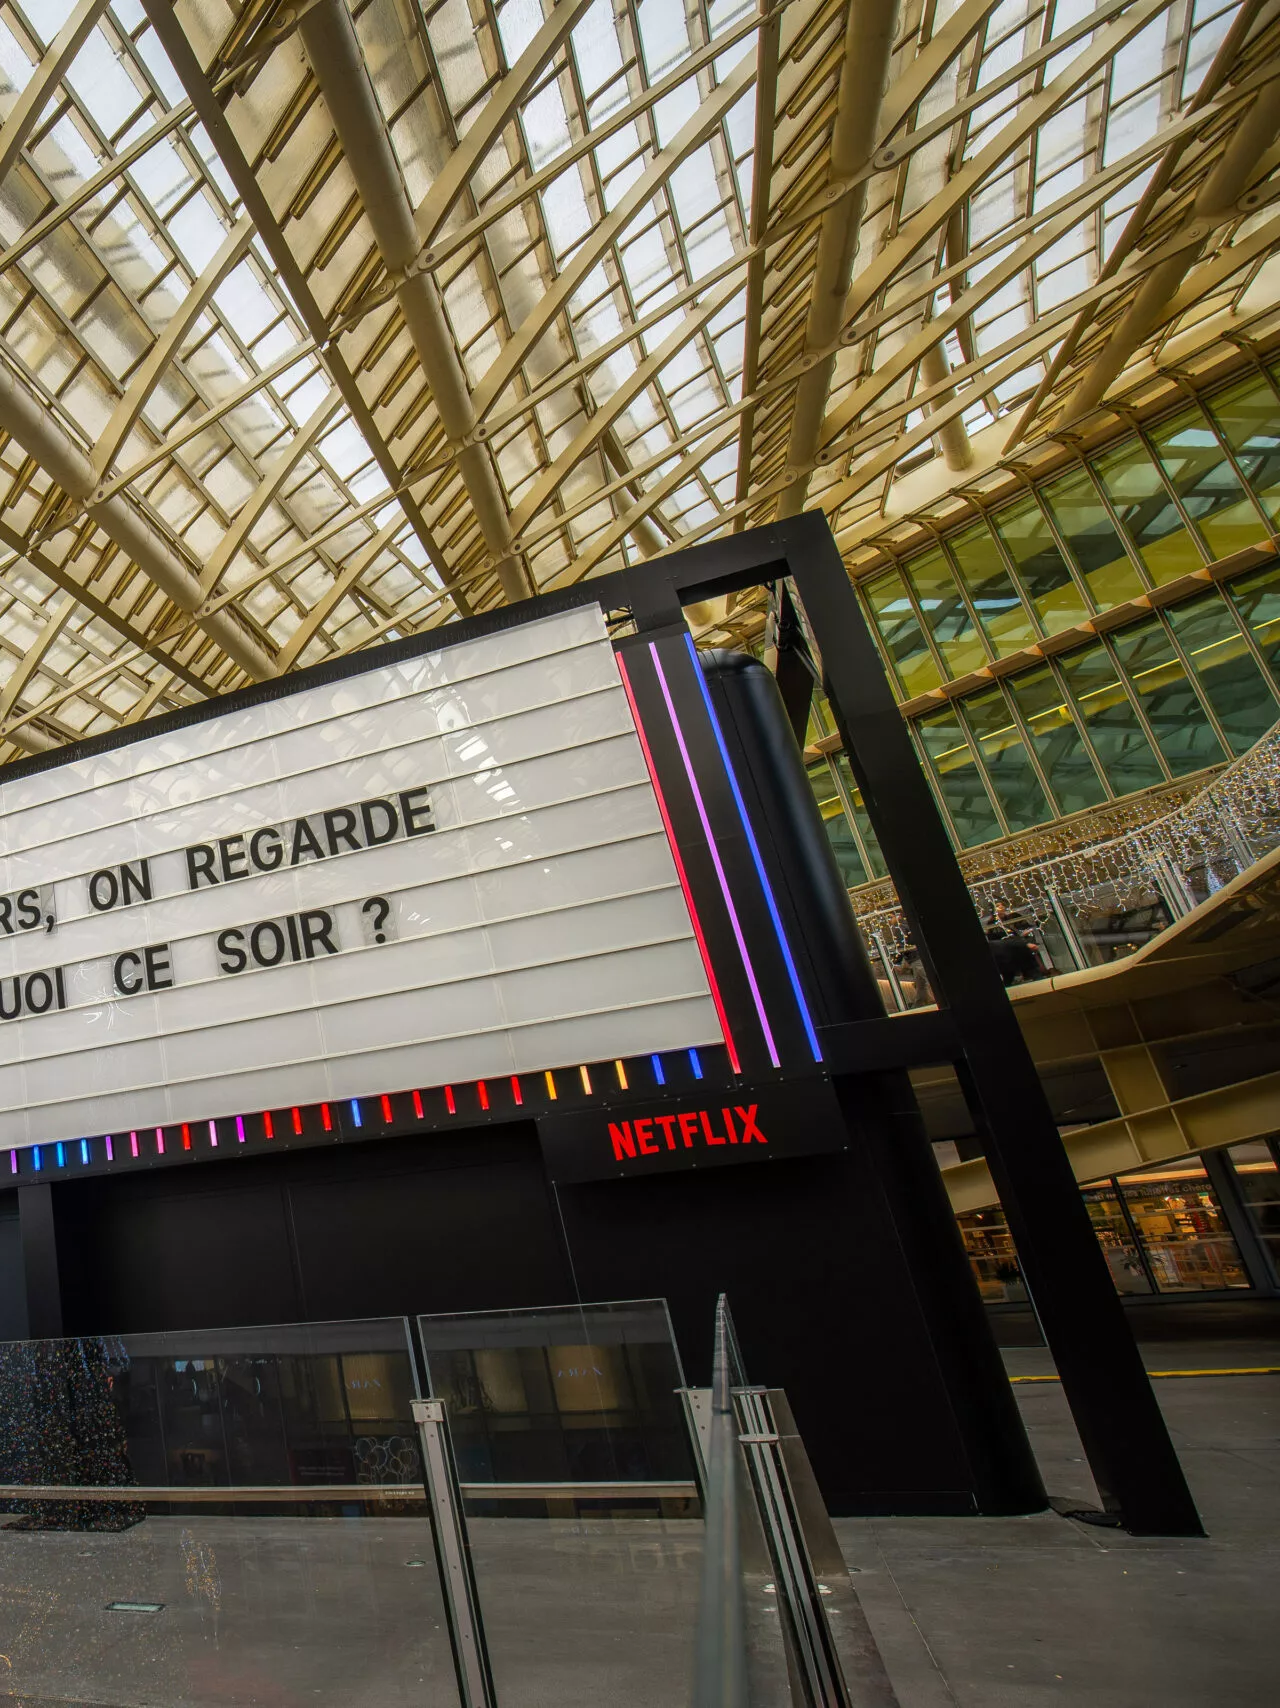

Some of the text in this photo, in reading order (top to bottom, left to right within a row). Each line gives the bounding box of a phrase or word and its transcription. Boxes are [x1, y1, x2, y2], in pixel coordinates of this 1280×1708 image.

[89, 858, 152, 911] ON
[185, 786, 436, 890] REGARDE
[113, 943, 173, 995] CE
[217, 909, 339, 974] SOIR
[362, 896, 390, 944] ?
[607, 1103, 768, 1161] NETFLIX
